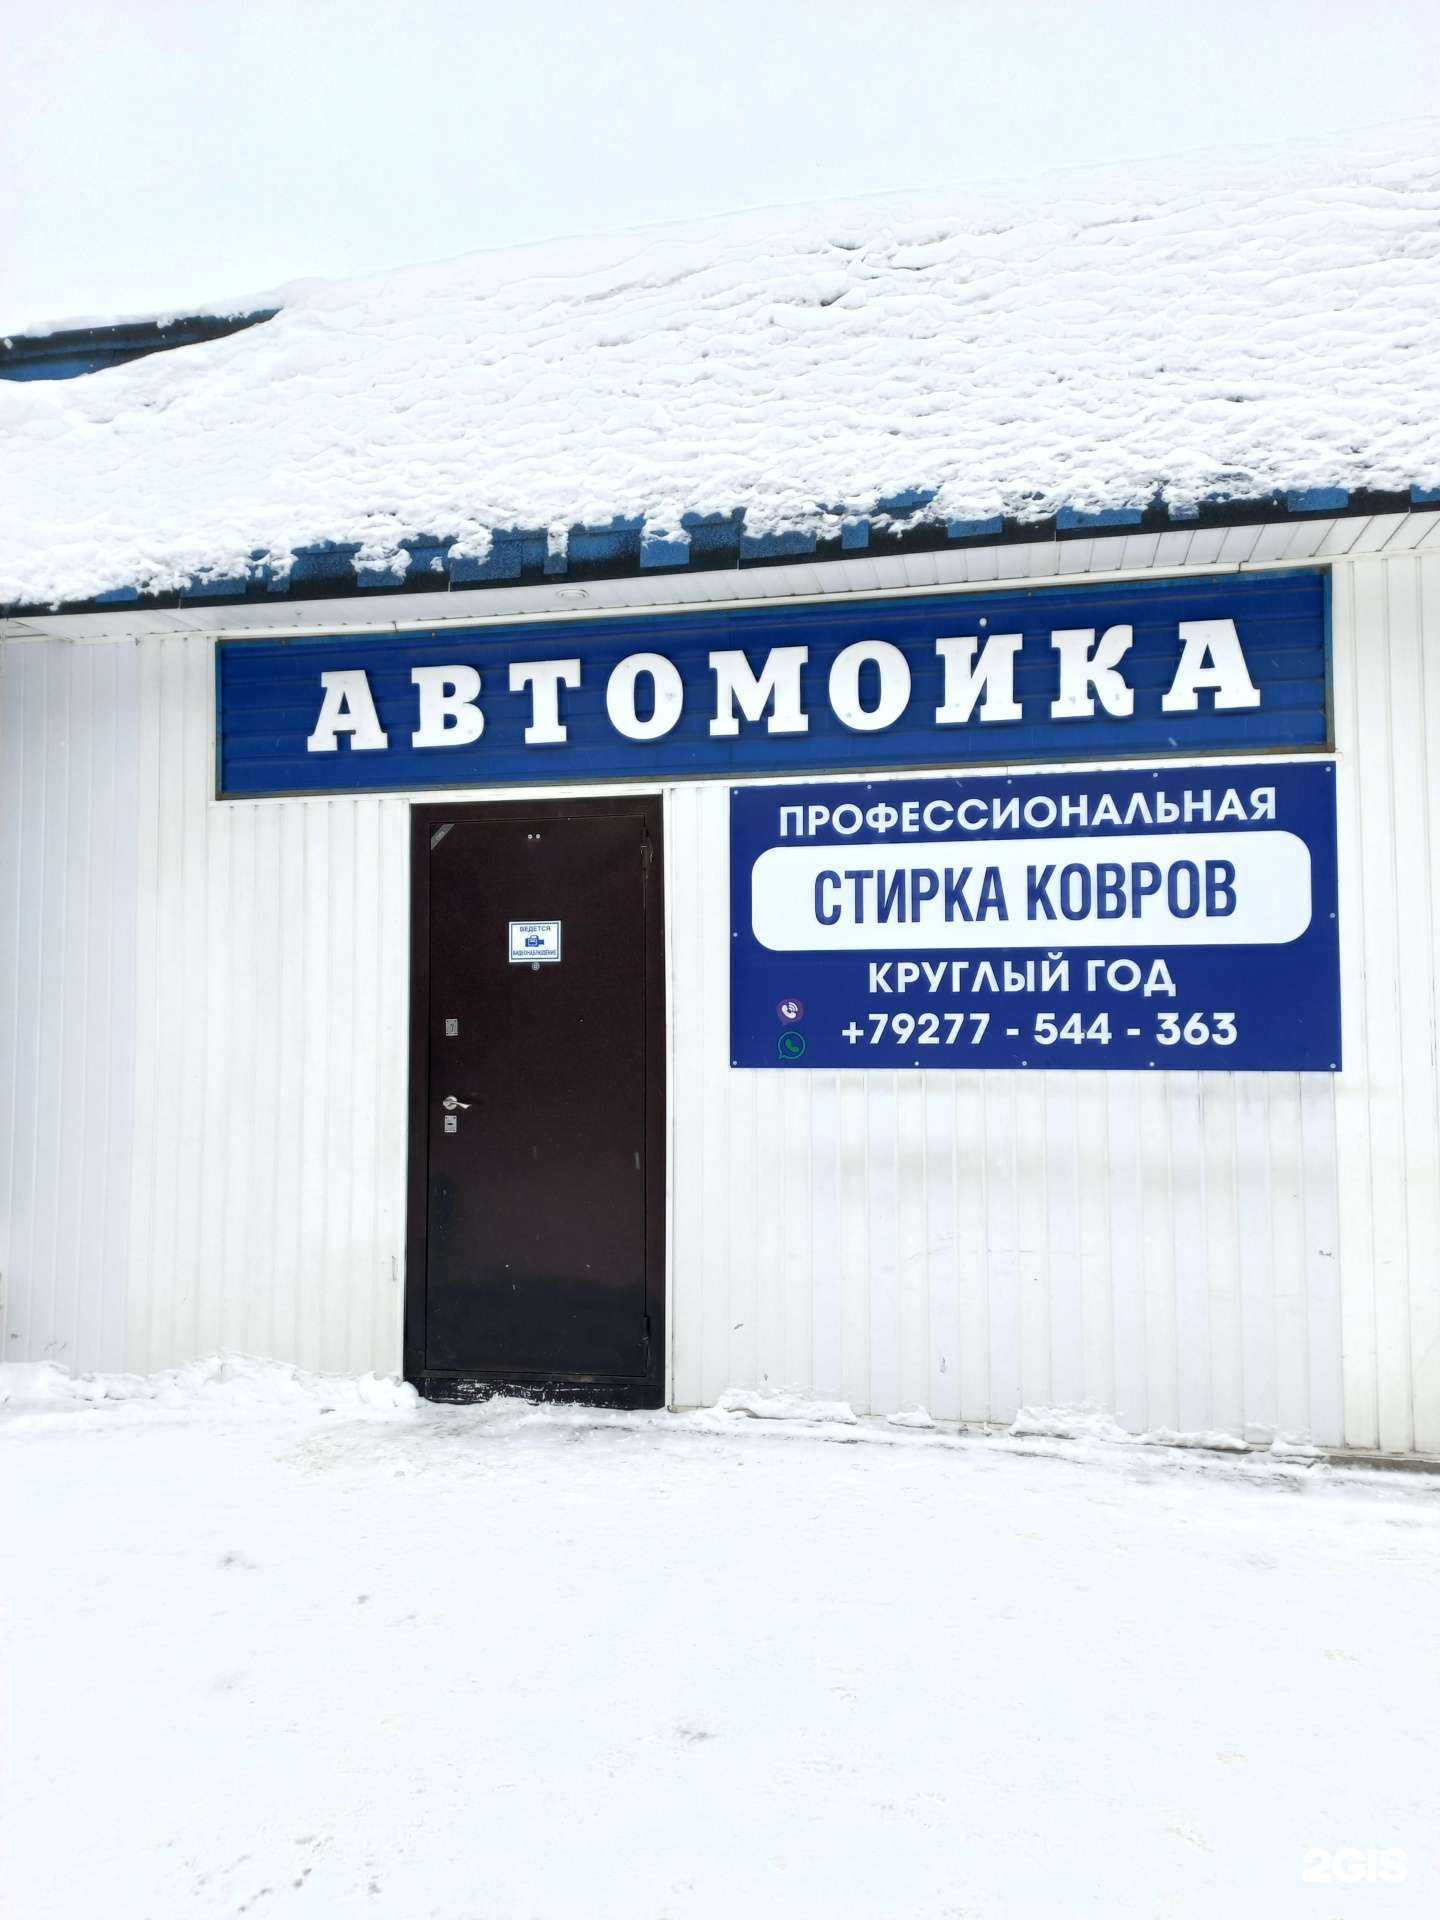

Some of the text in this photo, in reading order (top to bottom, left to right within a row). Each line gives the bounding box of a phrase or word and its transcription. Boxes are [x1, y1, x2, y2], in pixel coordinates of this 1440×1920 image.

[778, 786, 1277, 837] ПРОФЕССИОНАЛЬНАЯ
[813, 859, 1238, 926] СТИРКА КОВРОВ
[868, 951, 1178, 997] КРУГЛЫЙ ГОД
[841, 1012, 991, 1045] +79277
[1033, 1012, 1113, 1045] 544
[1155, 1012, 1238, 1046] 363
